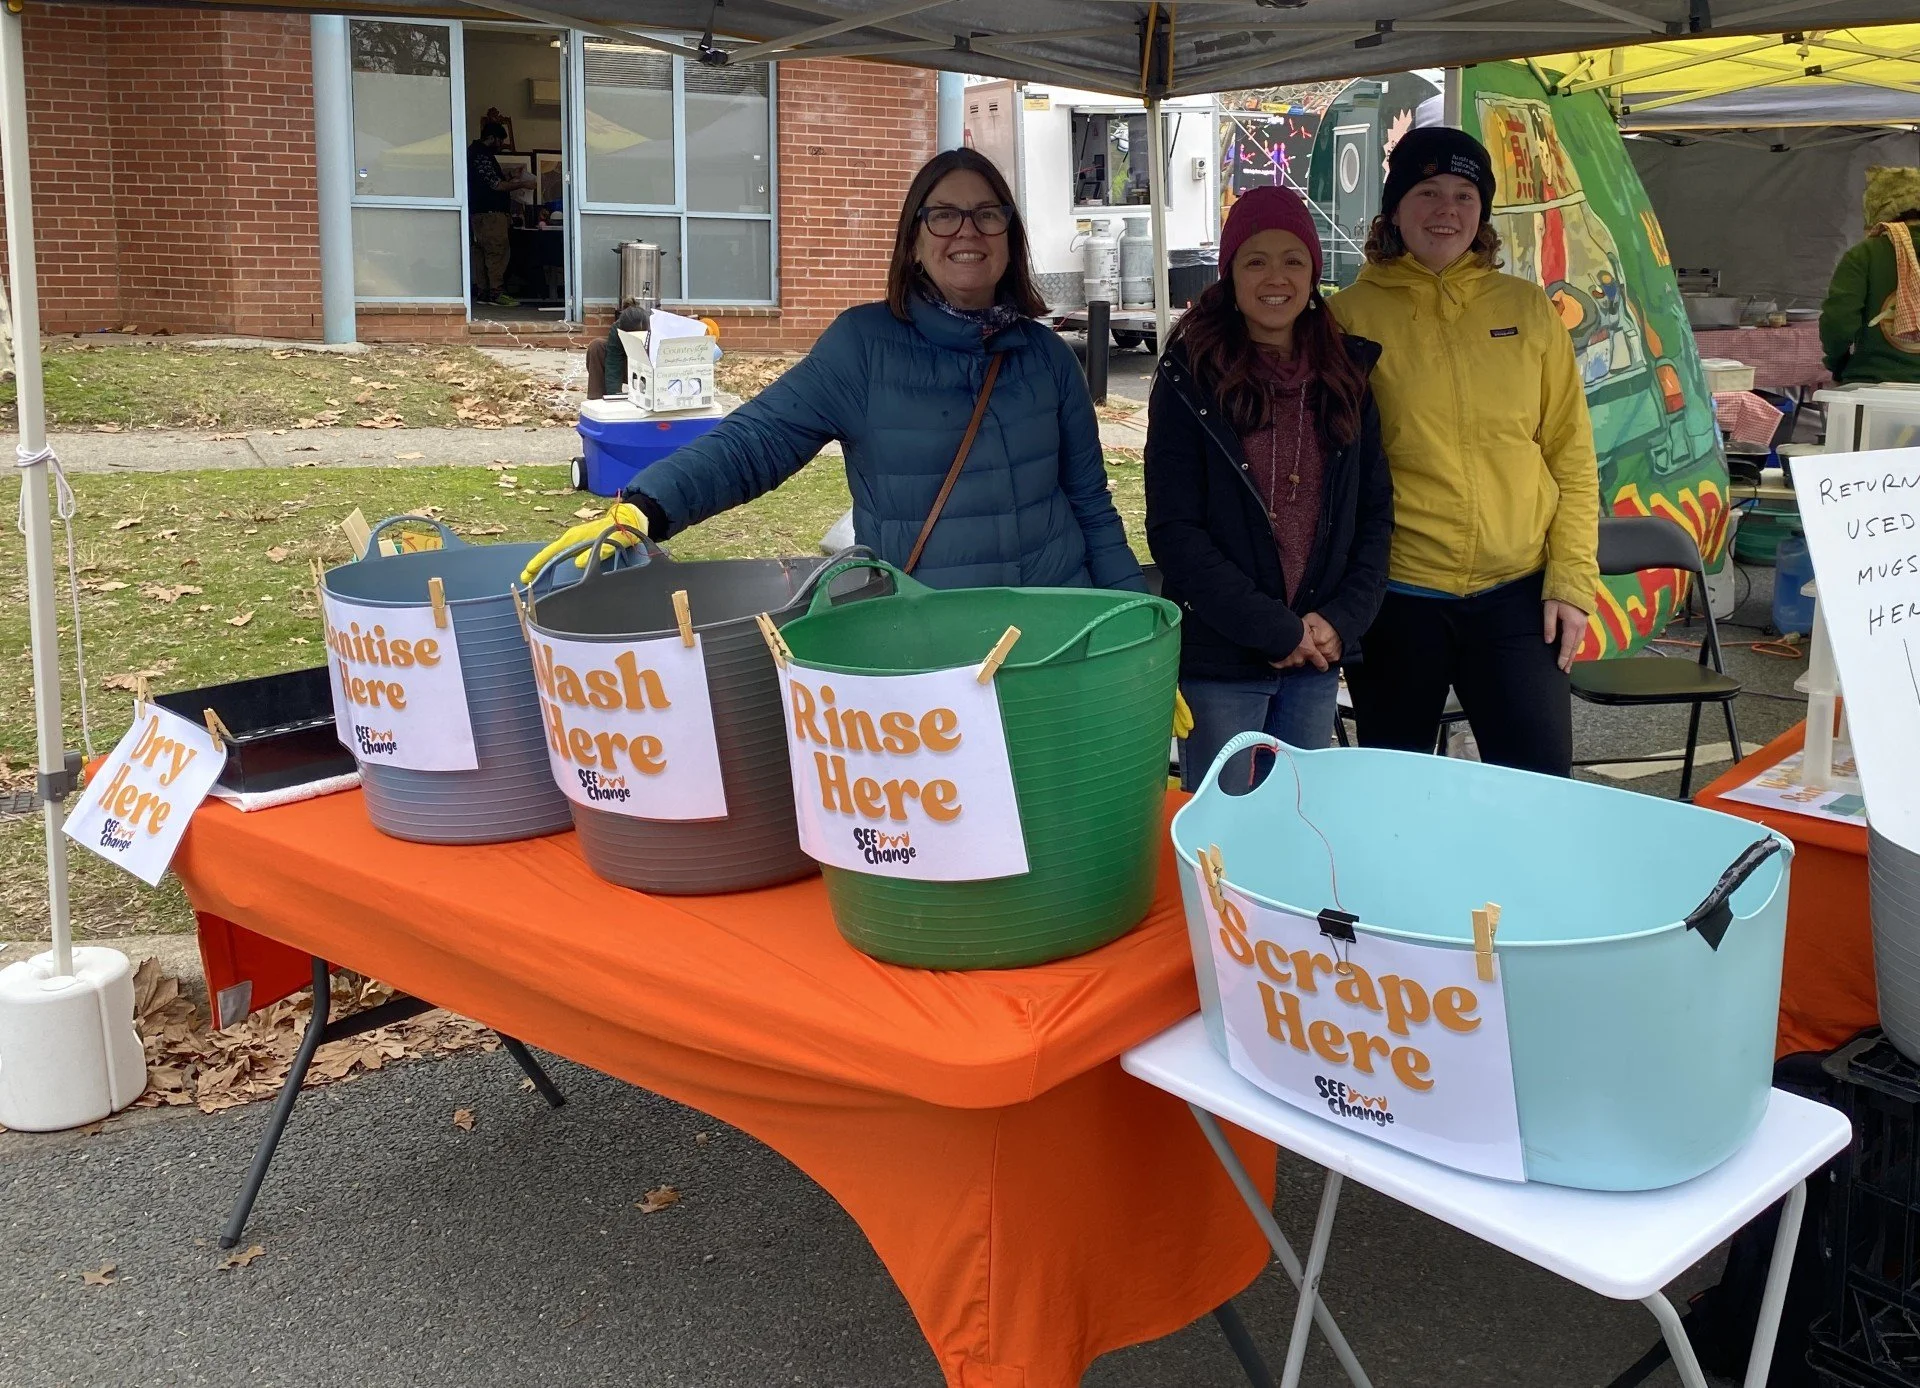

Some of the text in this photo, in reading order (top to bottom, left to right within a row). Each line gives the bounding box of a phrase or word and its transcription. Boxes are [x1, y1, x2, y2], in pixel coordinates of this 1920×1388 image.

[1450, 166, 1480, 182] University
[1451, 160, 1475, 173] National
[1452, 154, 1481, 171] Australian
[1819, 473, 1920, 505] RETURN
[1847, 513, 1915, 540] USED
[1858, 555, 1918, 585] MUGS
[338, 658, 407, 710] Here
[531, 638, 672, 710] Wash
[789, 679, 962, 755] Rinse
[355, 725, 371, 743] SEE
[361, 739, 398, 755] Change
[541, 696, 667, 775] Here
[131, 715, 198, 786] Dry
[577, 768, 598, 788] SEE
[814, 752, 962, 822] Here
[99, 763, 171, 836] Here
[586, 785, 631, 803] Change
[101, 818, 120, 835] SEE
[853, 827, 878, 851] SEE
[100, 833, 132, 852] Change
[863, 846, 917, 865] Change
[1219, 898, 1482, 1036] Scrape
[1257, 980, 1435, 1092] Here
[1314, 1075, 1347, 1099] SEE
[1327, 1097, 1395, 1127] Change
